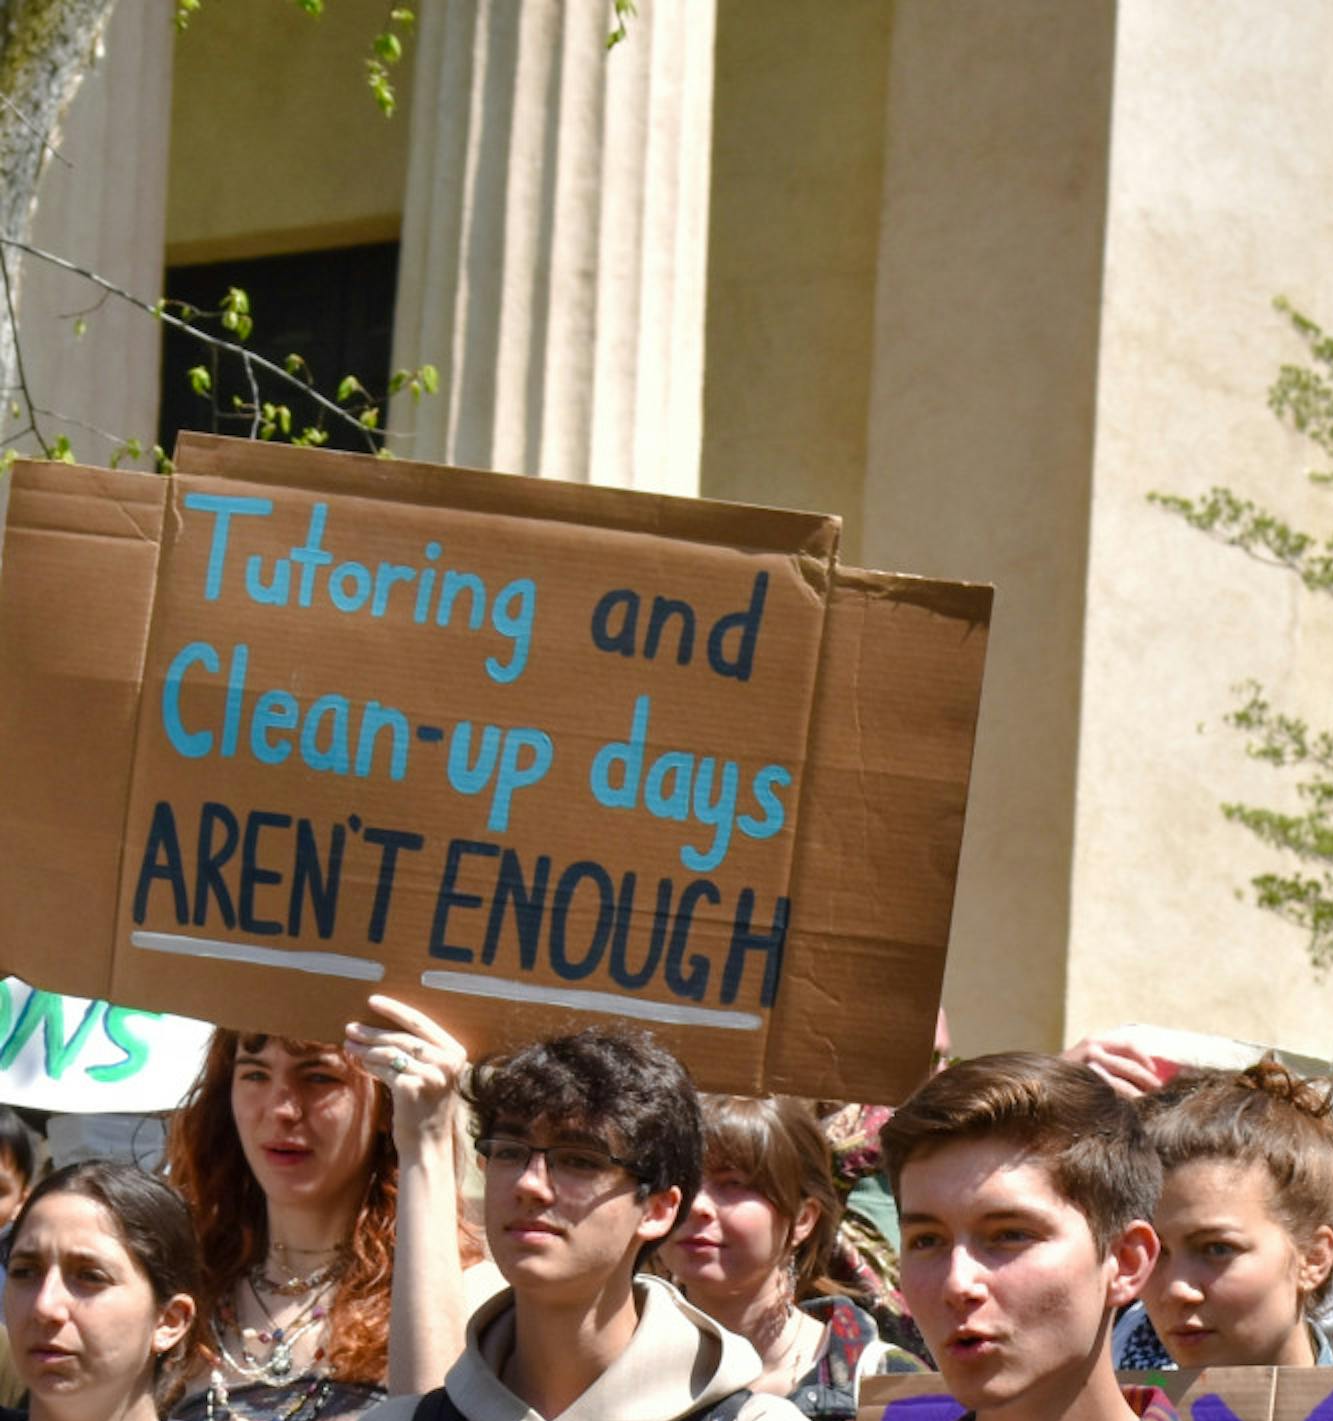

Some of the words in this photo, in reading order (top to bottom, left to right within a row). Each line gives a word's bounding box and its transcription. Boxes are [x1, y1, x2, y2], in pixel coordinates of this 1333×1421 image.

[184, 492, 538, 683] Tutoring
[590, 572, 769, 681] and
[160, 641, 553, 831] Clean-up
[590, 695, 792, 872] days
[131, 802, 423, 945] AREN'T
[427, 839, 792, 1008] ENOUGH
[0, 982, 163, 1083] NS
